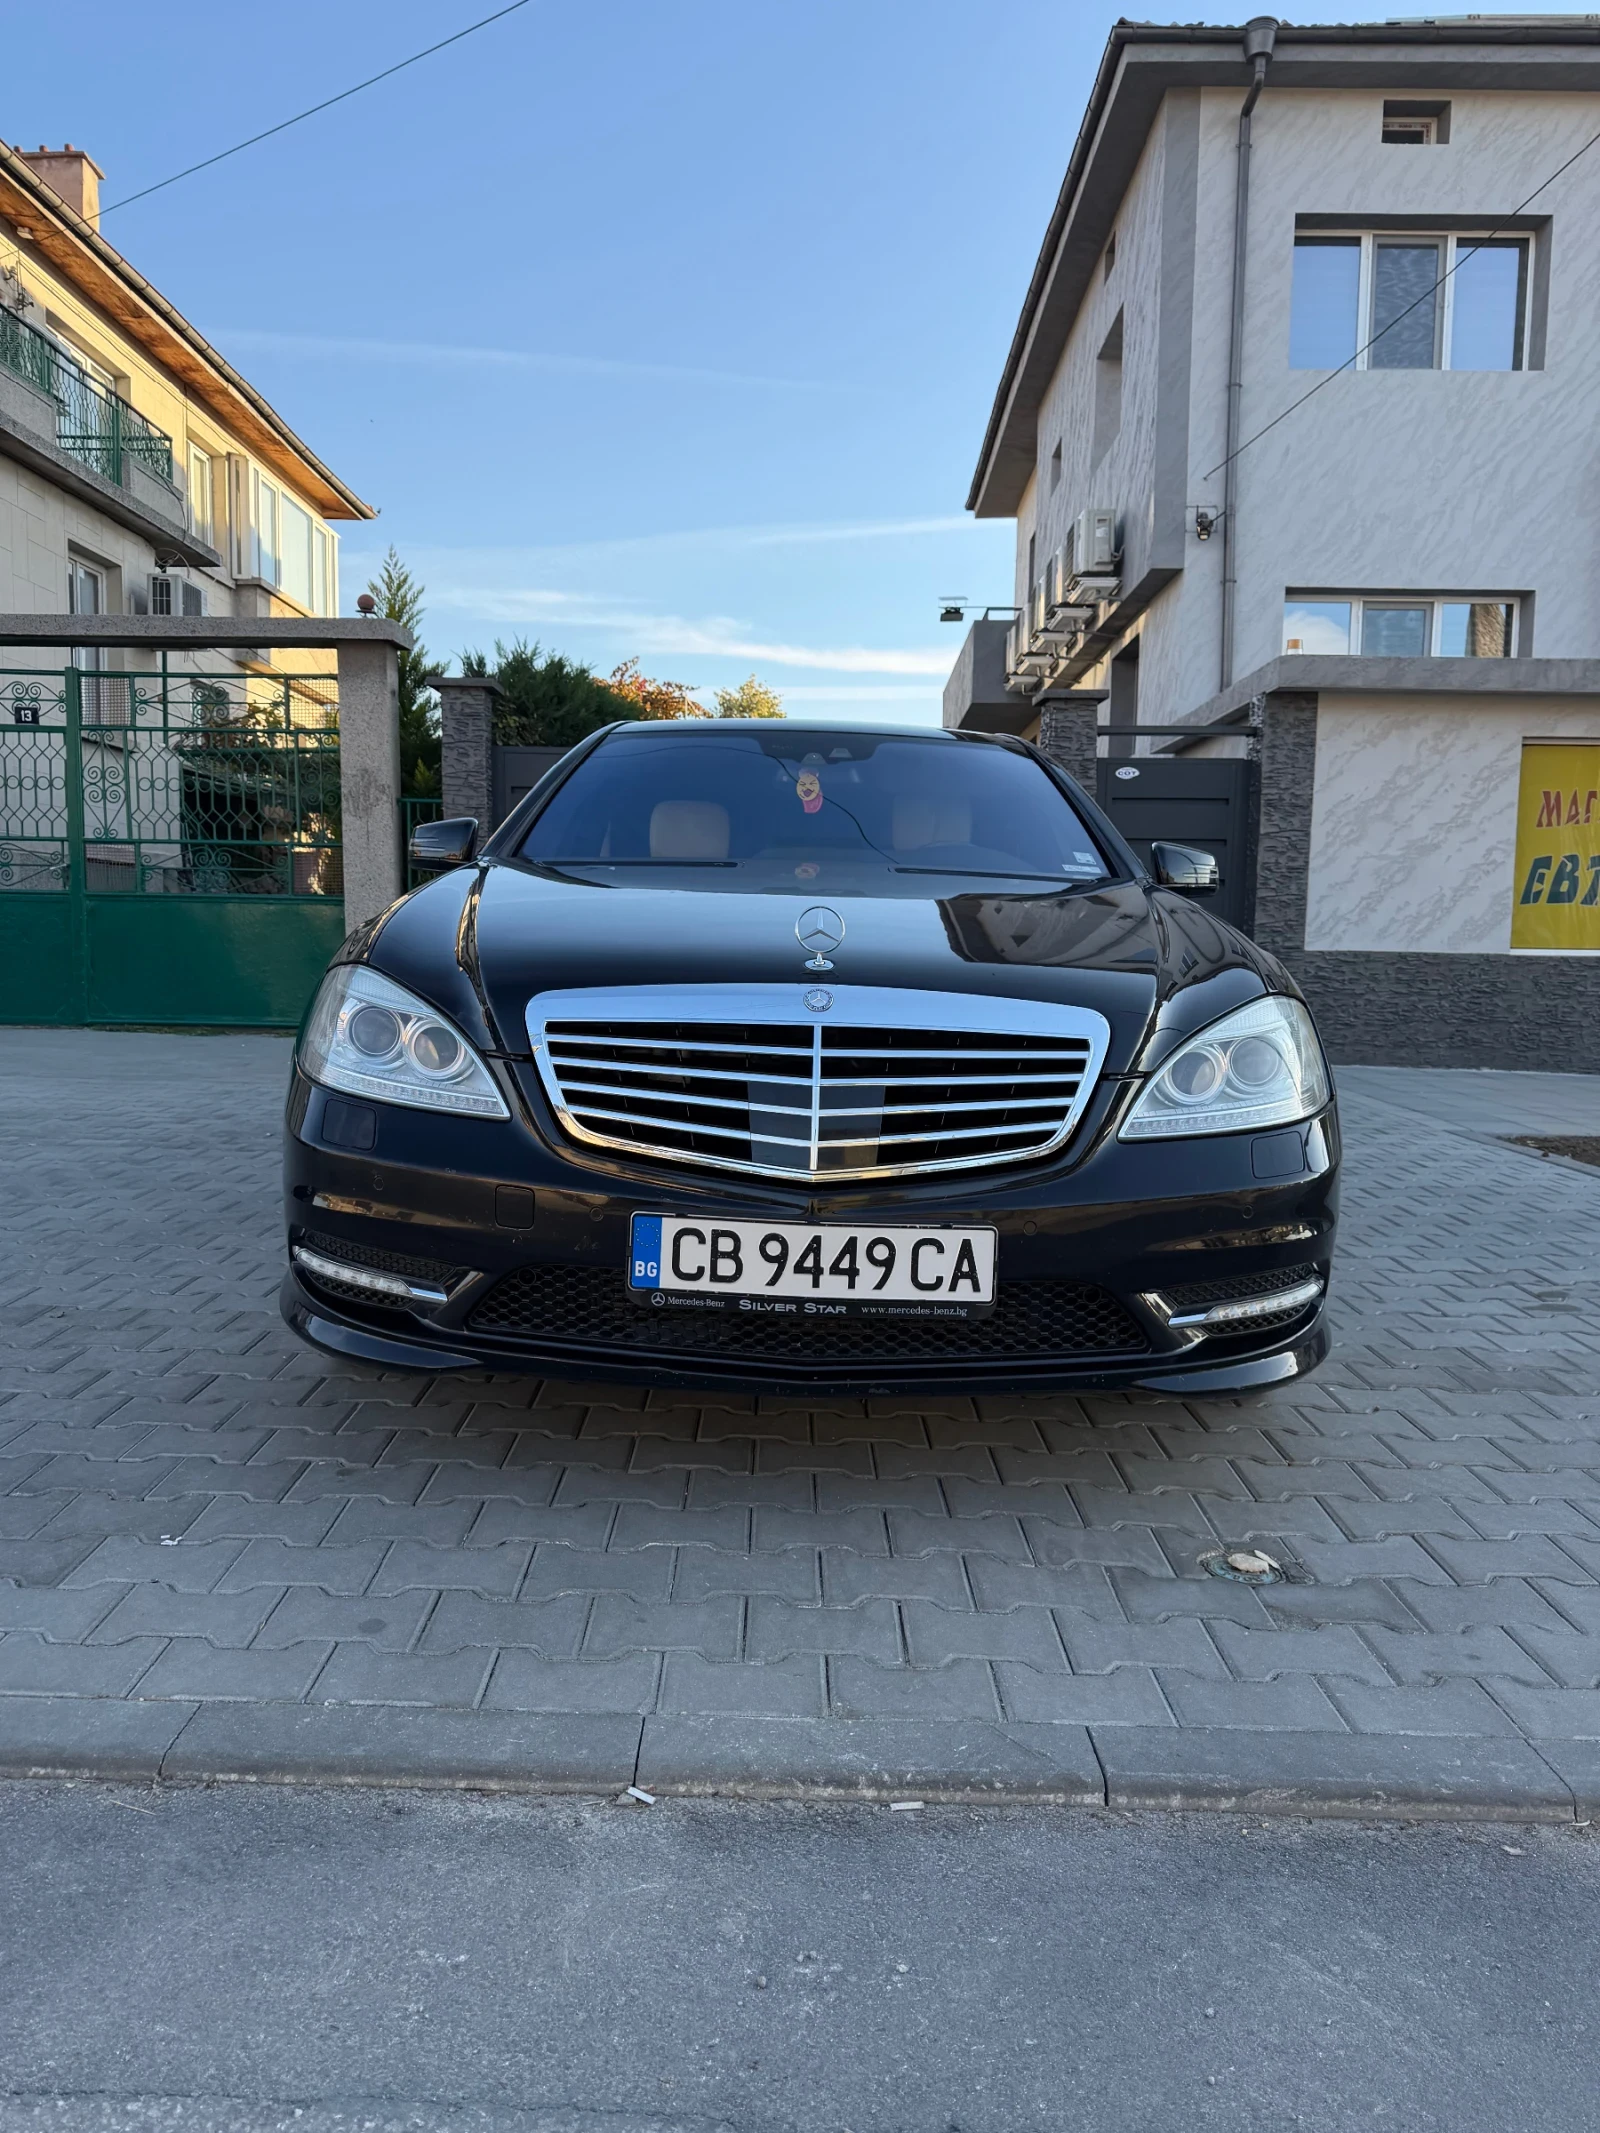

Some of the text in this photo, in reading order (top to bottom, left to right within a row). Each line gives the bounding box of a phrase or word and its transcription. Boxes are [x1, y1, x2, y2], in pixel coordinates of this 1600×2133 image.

[21, 710, 32, 722] 13
[671, 1227, 981, 1293] CB 9449 CA
[635, 1260, 658, 1278] BG
[667, 1296, 726, 1308] Mercedes-Benz
[860, 1305, 968, 1318] www.mercedes-benz.bg
